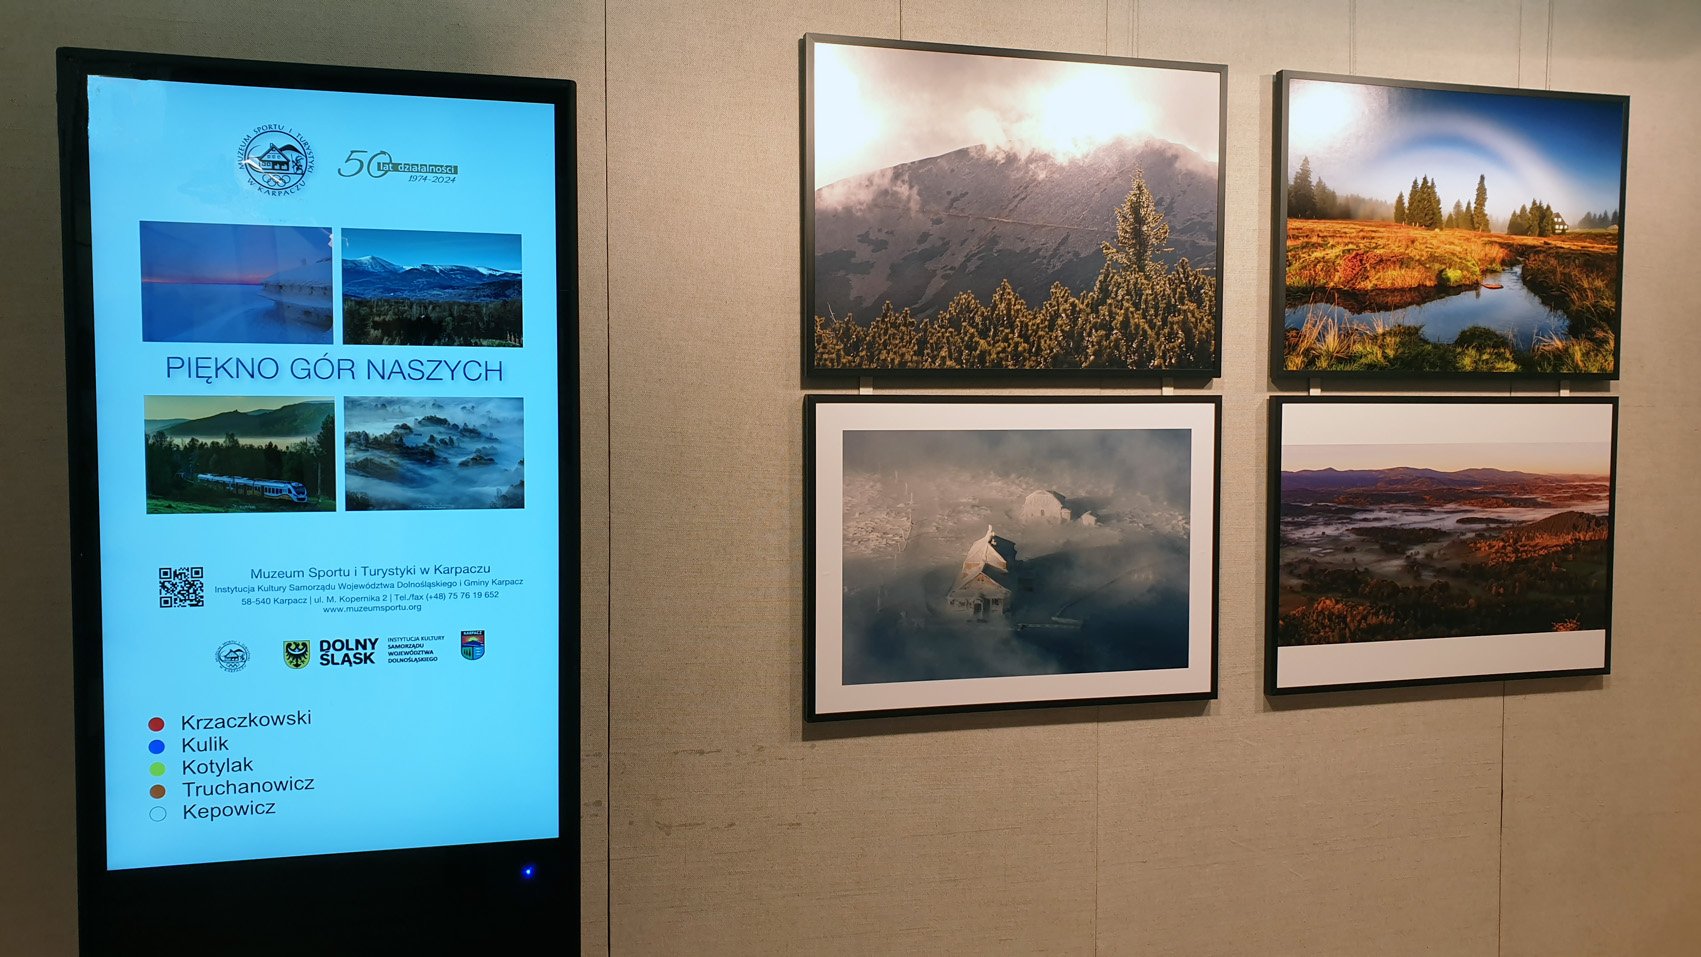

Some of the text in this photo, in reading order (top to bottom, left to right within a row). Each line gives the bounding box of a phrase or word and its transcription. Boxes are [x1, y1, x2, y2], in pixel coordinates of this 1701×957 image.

[253, 124, 285, 135] SPORTU
[296, 133, 315, 173] TURYSTYKI
[337, 150, 393, 179] 50
[380, 162, 455, 174] lat działalności
[408, 175, 456, 184] 1974-2024
[257, 180, 306, 197] KARPACZU
[166, 353, 504, 384] PIĘKNO GÓR NASZYCH
[250, 568, 305, 579] Muzeum
[308, 566, 350, 580] Sportu
[361, 564, 416, 578] Turystyki
[434, 564, 491, 576] Karpaczu
[214, 585, 255, 594] Instytucja
[257, 583, 287, 593] Kultury
[289, 582, 336, 592] Samorządu
[337, 580, 395, 591] Województwa
[397, 579, 458, 589] Dolnośląskiego
[463, 578, 490, 587] Gminy
[491, 578, 524, 586] Karpacz
[241, 597, 271, 606] 58-540
[273, 596, 308, 605] Karpacz
[339, 593, 380, 603] Kopernika
[395, 592, 424, 601] Tel./fax
[426, 592, 446, 601] (+48)
[460, 591, 471, 600] 76
[484, 590, 500, 599] 652
[322, 603, 422, 613] www.muzeumsportu.org
[319, 638, 379, 652] DOLNY
[319, 650, 375, 667] ŚLĄSK
[181, 710, 312, 731] Krzaczkowski
[182, 736, 229, 753] Kulik
[182, 757, 254, 777] Kotylak
[182, 776, 315, 798] Truchanowicz
[183, 800, 276, 822] Kepowicz
